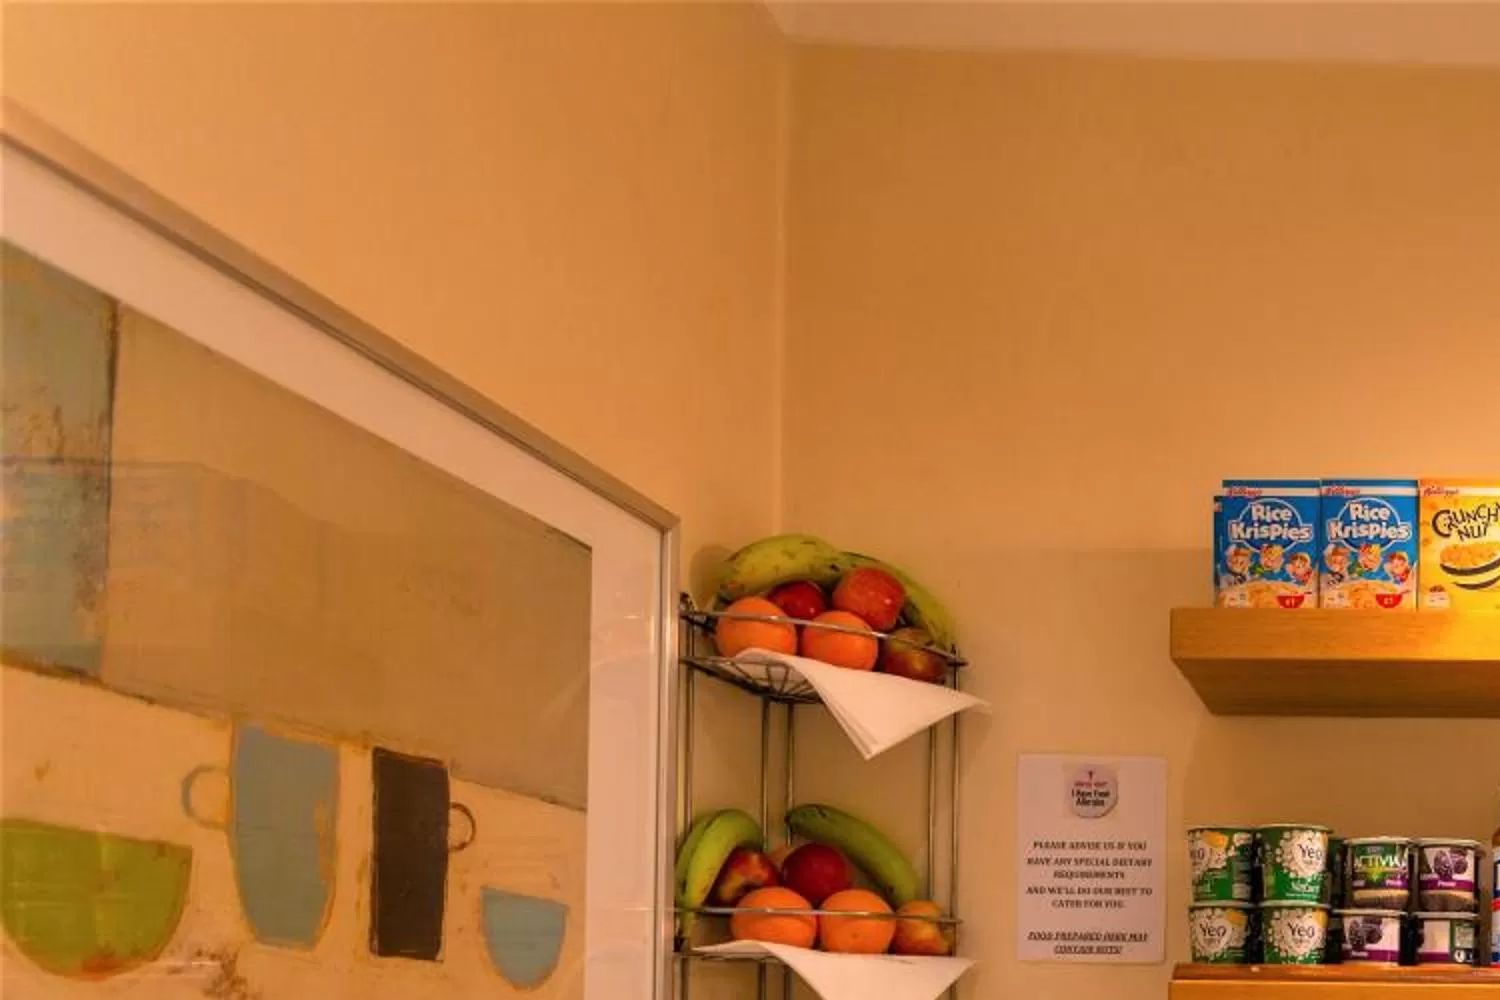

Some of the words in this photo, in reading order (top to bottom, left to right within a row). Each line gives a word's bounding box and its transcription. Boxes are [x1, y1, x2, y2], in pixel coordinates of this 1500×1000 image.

[1251, 503, 1293, 523] Rice
[1349, 502, 1391, 521] Rice
[1230, 521, 1310, 541] Krispies
[1327, 520, 1411, 541] Krispies
[1456, 521, 1490, 541] NUT
[1033, 841, 1066, 850] PLEASE
[1103, 841, 1115, 850] US
[1127, 841, 1147, 850] YOU
[1297, 842, 1323, 859] Yeo
[1026, 857, 1051, 866] HAVE
[1054, 858, 1072, 867] ANY
[1073, 858, 1110, 867] SPECIAL
[1112, 858, 1153, 867] DIETARY
[1026, 887, 1046, 895] AND
[1139, 887, 1153, 896] TO
[1051, 900, 1082, 909] CATER
[1083, 900, 1103, 909] FOR
[1199, 921, 1228, 938] Yeo
[1287, 920, 1316, 938] Yeo
